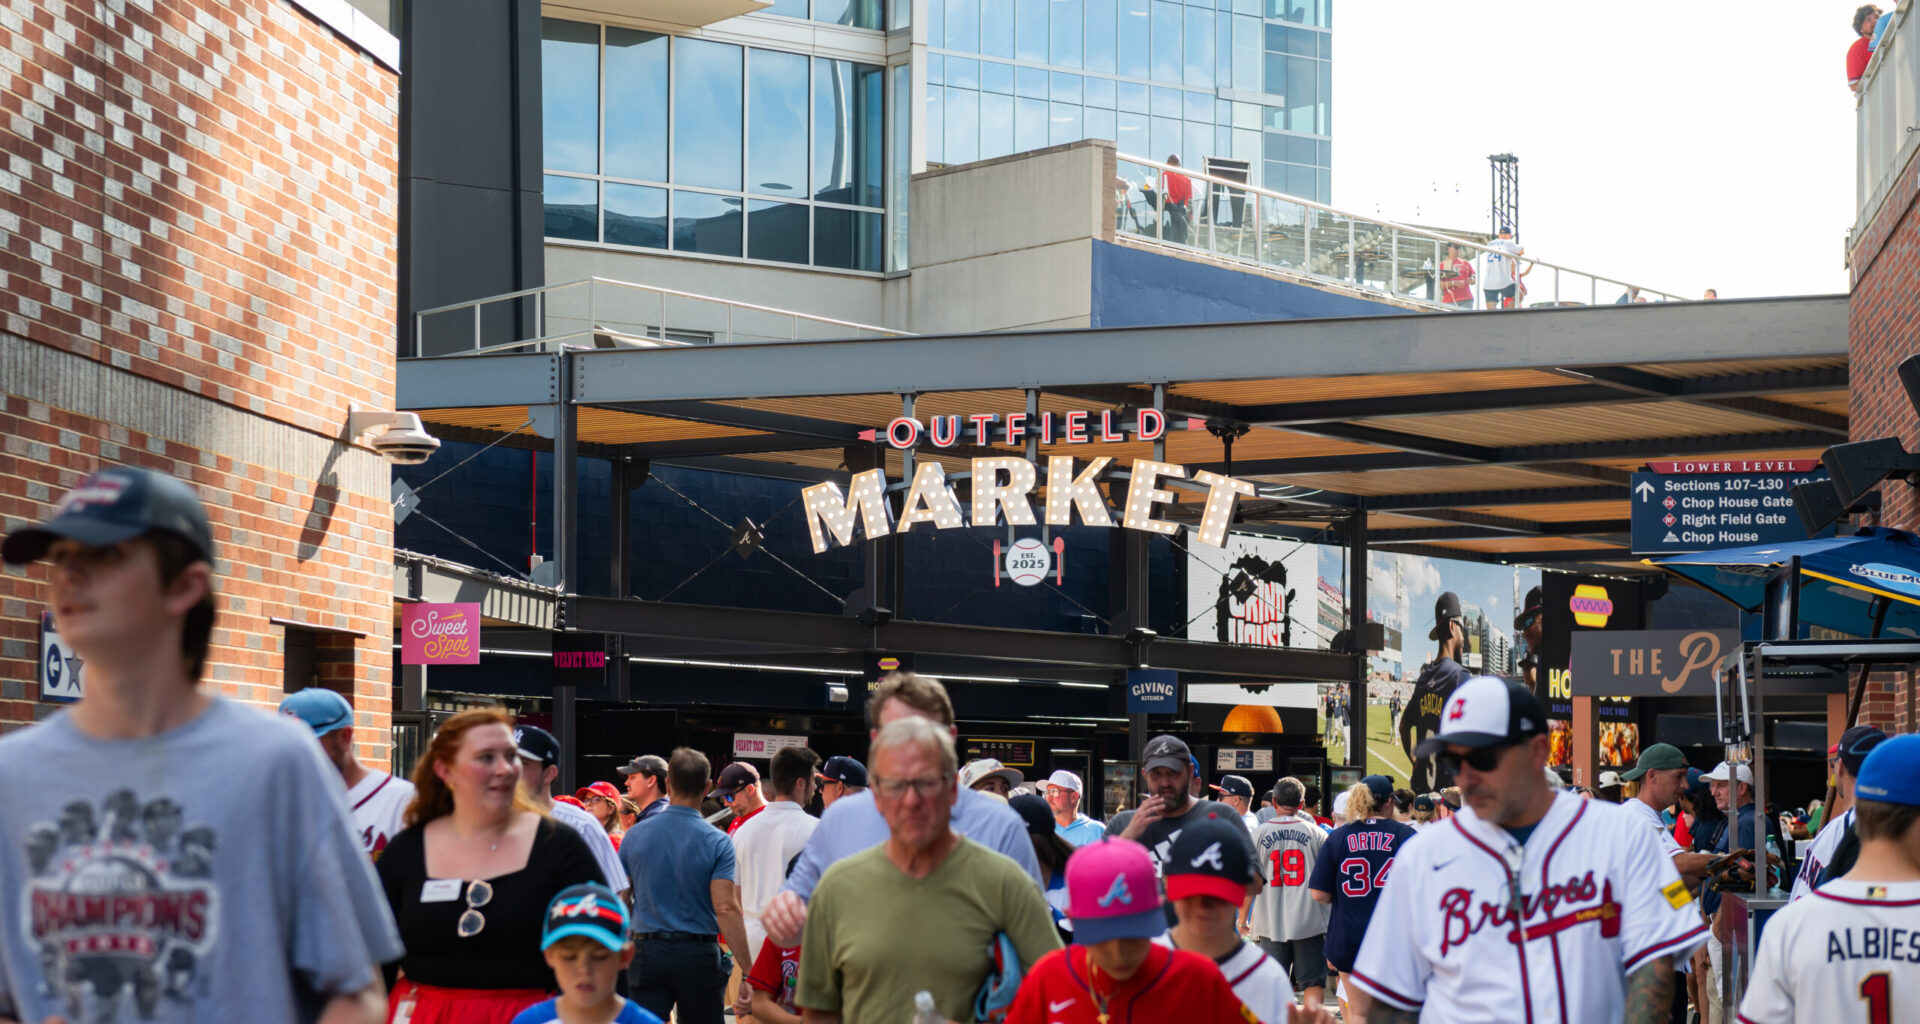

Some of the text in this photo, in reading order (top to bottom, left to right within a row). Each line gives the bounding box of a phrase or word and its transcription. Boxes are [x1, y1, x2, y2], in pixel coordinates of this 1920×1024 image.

[886, 407, 1166, 449] OUTFIELD
[1673, 461, 1796, 473] LOWER LEVEL
[1664, 480, 1721, 491] Sections
[801, 455, 1256, 554] MARKET
[1681, 497, 1715, 510] Chop
[1718, 496, 1759, 508] House
[1762, 495, 1793, 507] Gate
[1681, 513, 1717, 527] Right
[1720, 513, 1752, 525] Field
[1755, 512, 1787, 525] Gate
[1681, 530, 1759, 544] Chop House
[1012, 559, 1045, 569] 2025
[411, 611, 468, 638] Sweet
[424, 634, 470, 659] Spot
[554, 651, 605, 668] VELVET TACO
[1610, 649, 1662, 675] THE
[1132, 682, 1174, 696] GIVING
[1549, 669, 1571, 699] HO
[1347, 832, 1395, 852] ORTIZ
[1269, 849, 1305, 887] 19
[1340, 857, 1397, 897] 34
[1827, 927, 1920, 964] ALBIES
[1858, 970, 1894, 1024] 1
